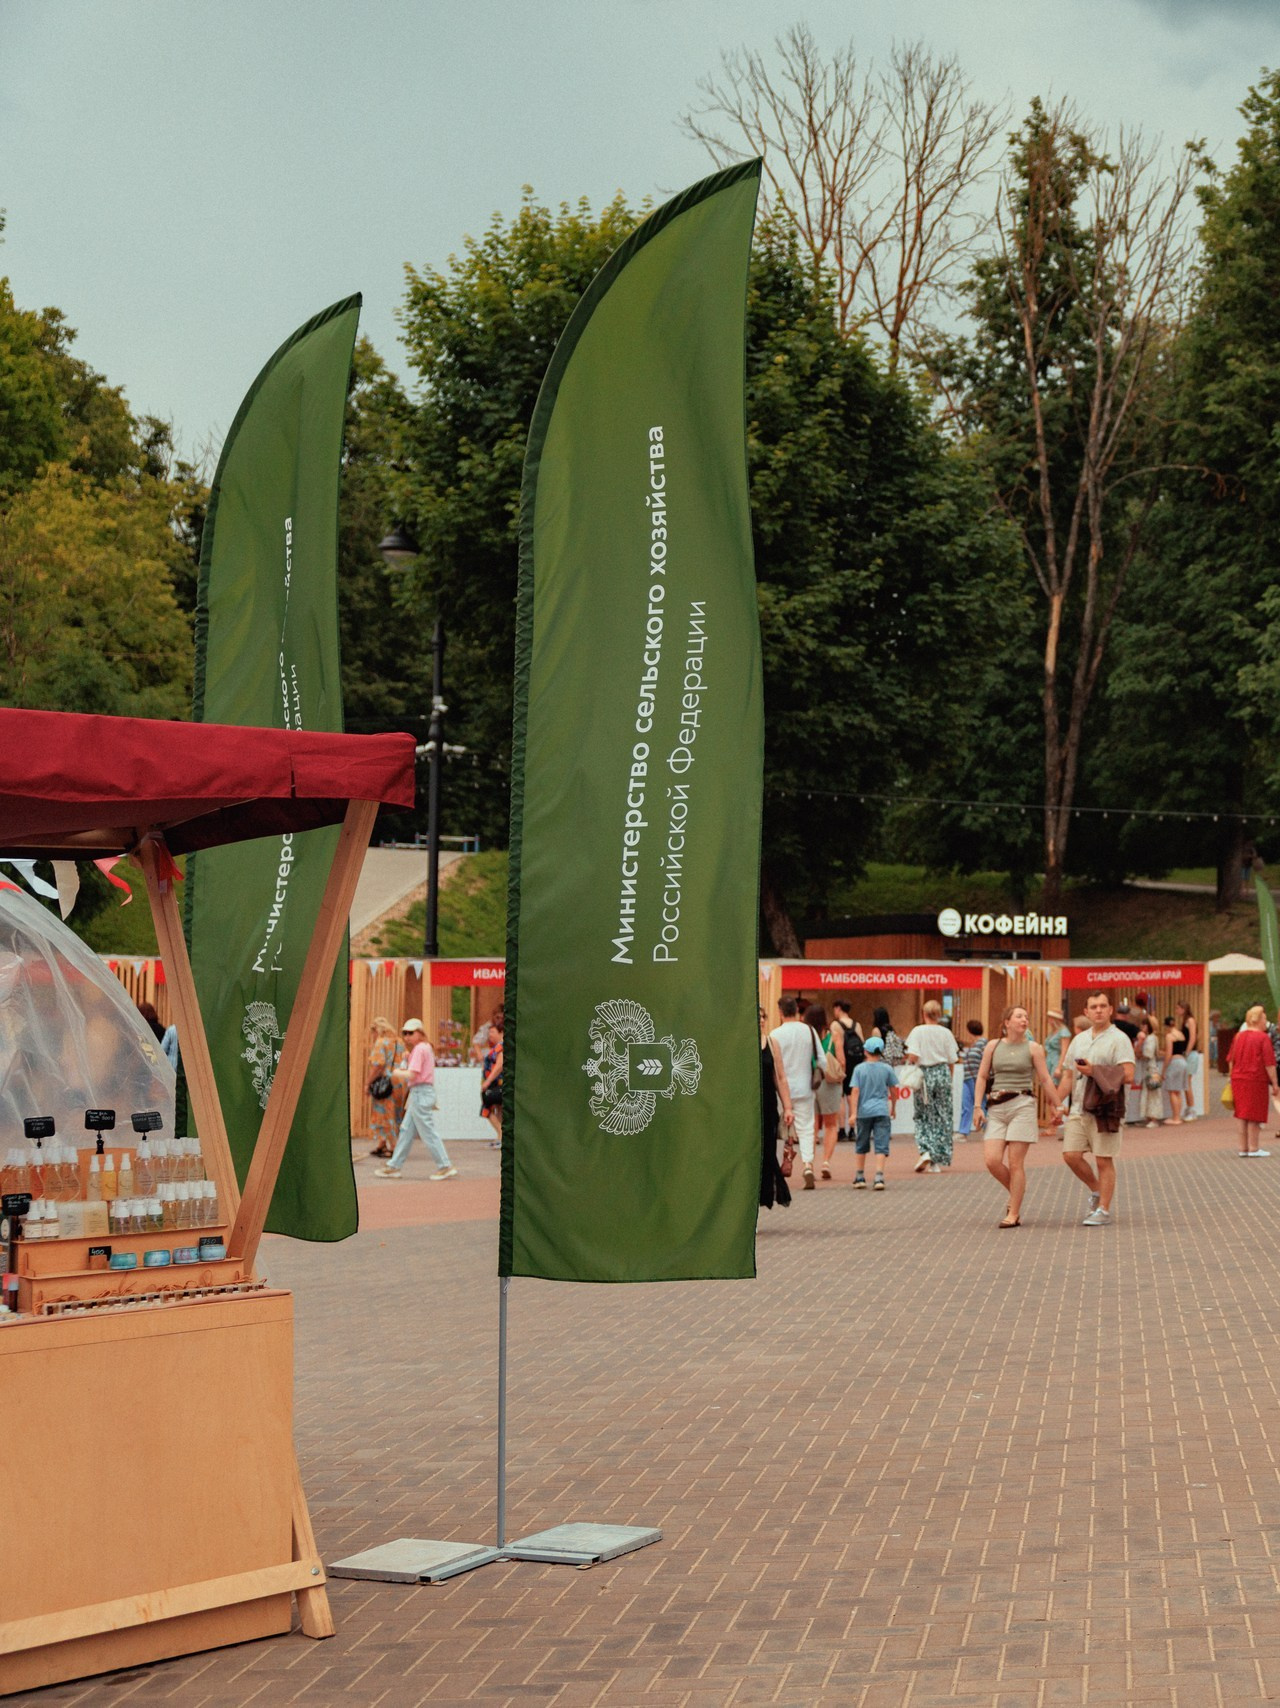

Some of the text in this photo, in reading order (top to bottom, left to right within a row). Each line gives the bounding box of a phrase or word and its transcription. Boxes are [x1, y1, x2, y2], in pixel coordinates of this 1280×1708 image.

[610, 425, 668, 965] Министерство сельского хозяйства
[652, 601, 709, 962] Российской Федерации
[964, 912, 1068, 935] КОФЕЙНЯ
[820, 972, 948, 984] ТАМБОВСКАЯ ОБЛАСТЬ
[1087, 969, 1182, 982] СТАВРОПОЛЬСКИЙ КРАЙ
